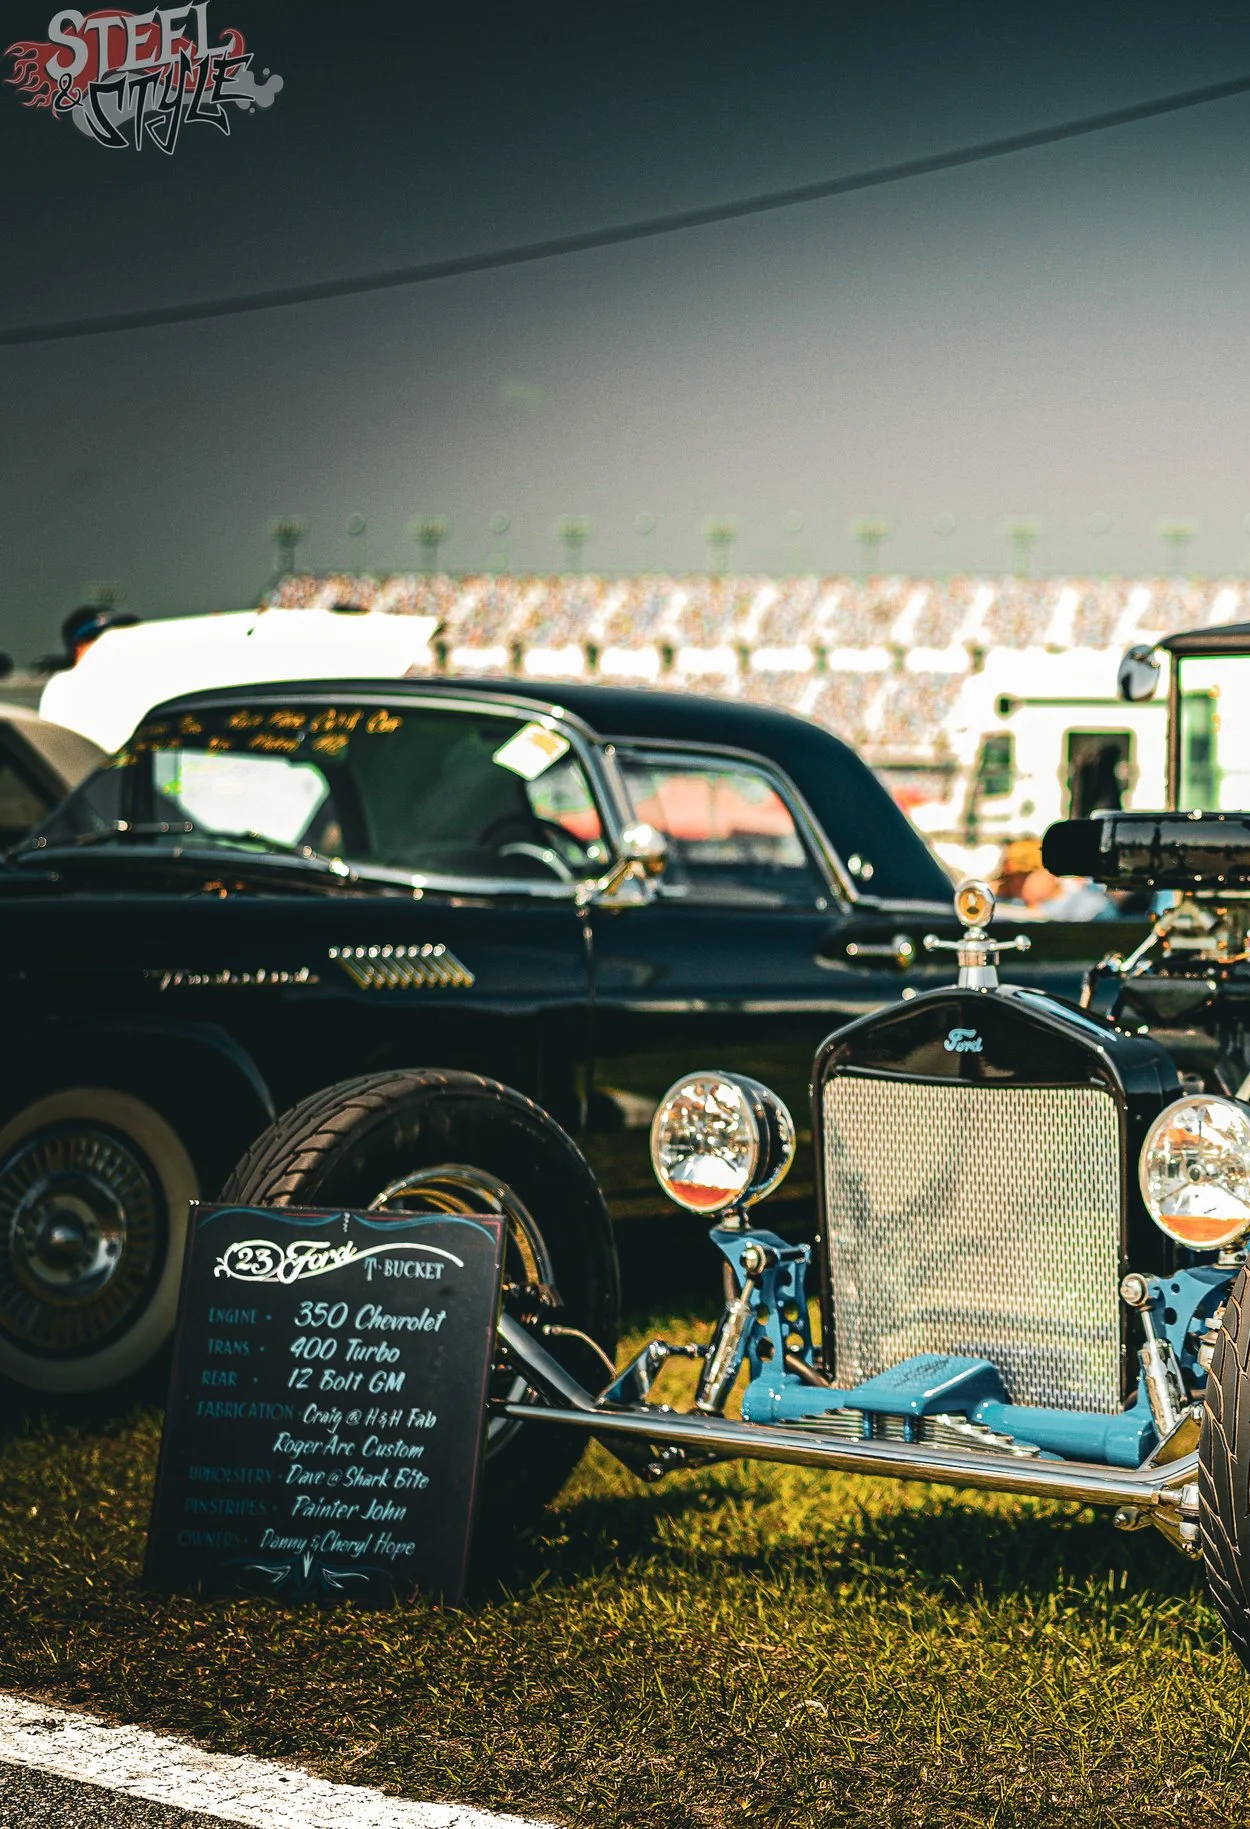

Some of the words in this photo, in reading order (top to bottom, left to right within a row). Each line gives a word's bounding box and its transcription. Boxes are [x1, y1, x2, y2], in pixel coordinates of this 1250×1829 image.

[943, 1028, 983, 1053] Ford
[234, 1248, 274, 1275] 23
[276, 1240, 357, 1285] Ford
[208, 1306, 258, 1325] ENGINE
[294, 1301, 349, 1330] 350
[354, 1303, 447, 1333] Chevrolet
[208, 1338, 250, 1356] TRANS
[290, 1336, 338, 1362] 400
[345, 1339, 401, 1364] Turbo
[201, 1370, 237, 1387] REAR
[287, 1367, 314, 1390] 12
[319, 1368, 364, 1392] Bolt
[368, 1372, 405, 1394] GM
[197, 1400, 294, 1420] FABRICATION
[302, 1402, 343, 1434] Craig
[406, 1407, 438, 1430] Fab
[272, 1431, 323, 1460] Roger
[361, 1435, 425, 1460] Custom
[285, 1464, 326, 1487] Dave
[342, 1465, 391, 1489] Shark
[393, 1467, 430, 1490] Bite
[290, 1495, 359, 1520] Painter
[360, 1498, 408, 1522] John
[260, 1528, 308, 1555] Danny
[320, 1529, 373, 1559] Cheryl
[373, 1532, 416, 1561] Hope
